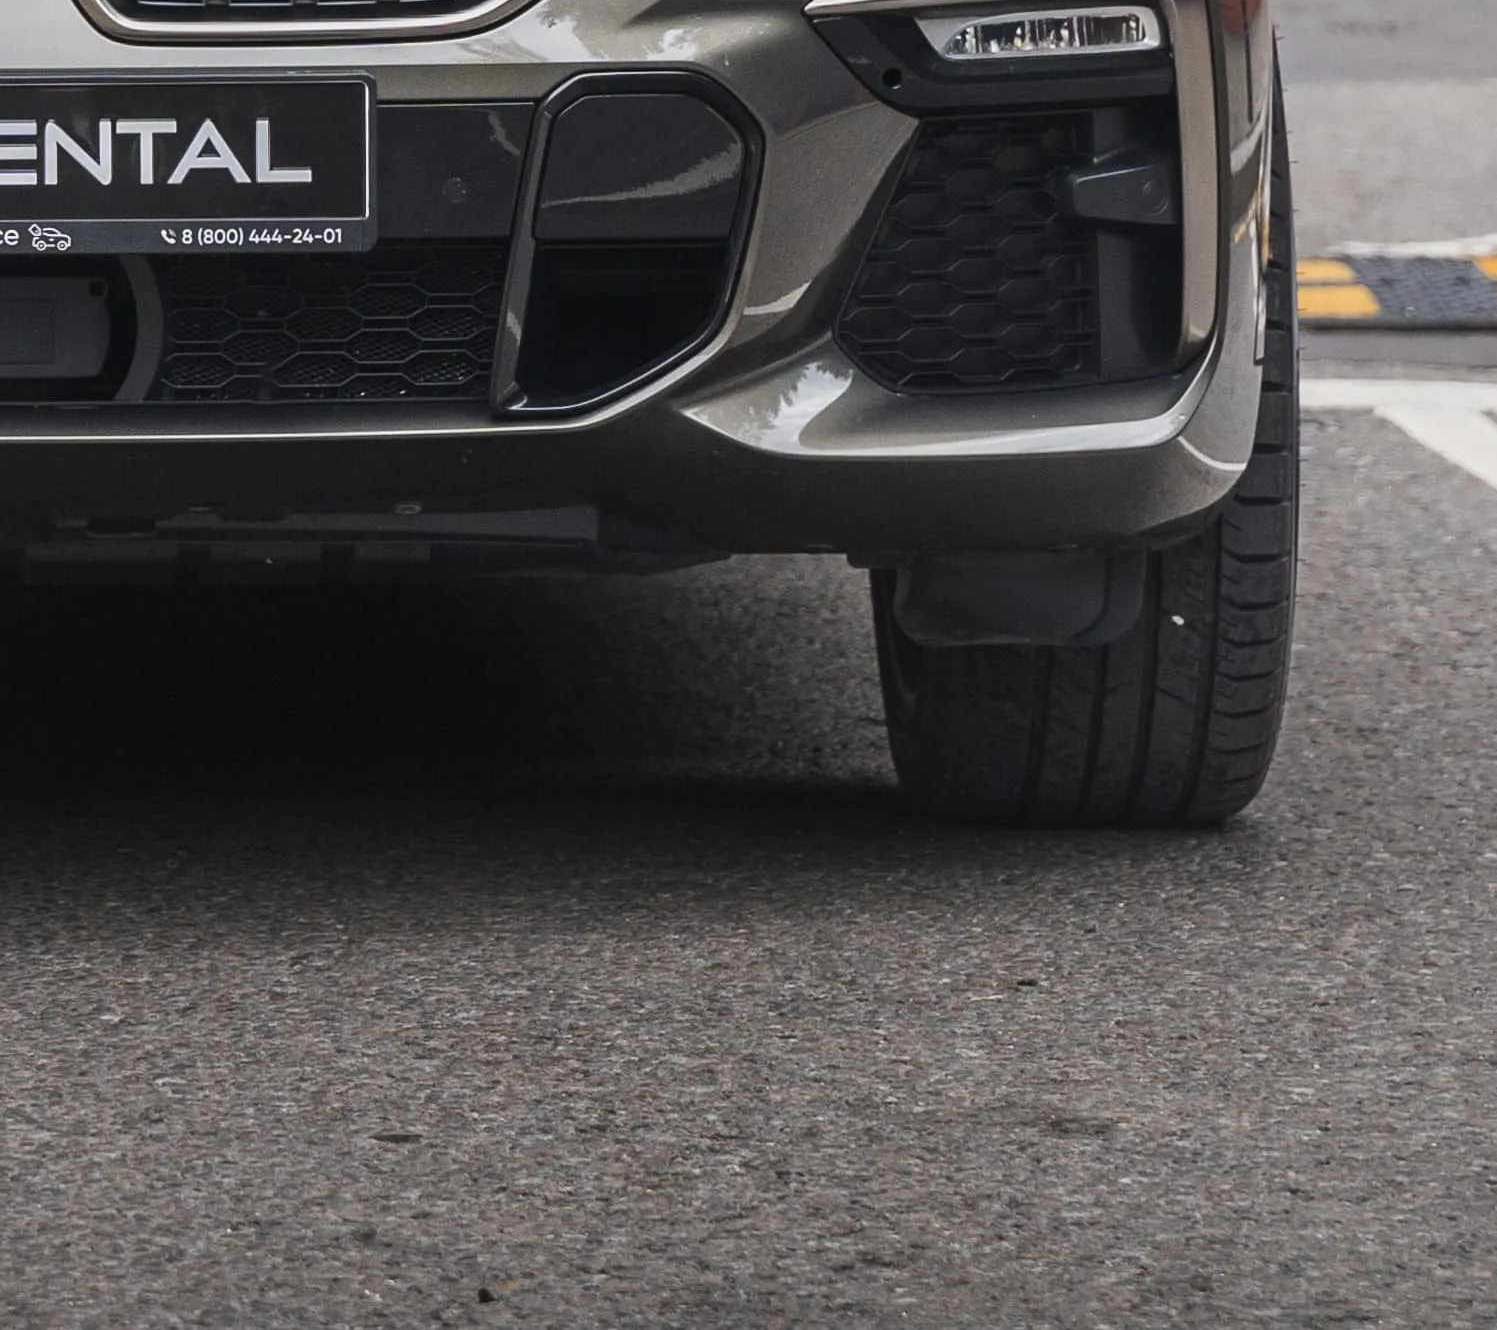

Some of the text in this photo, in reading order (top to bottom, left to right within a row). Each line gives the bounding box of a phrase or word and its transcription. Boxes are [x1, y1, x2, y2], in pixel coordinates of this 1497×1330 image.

[181, 227, 342, 246] 8 (800) 444-24-01
